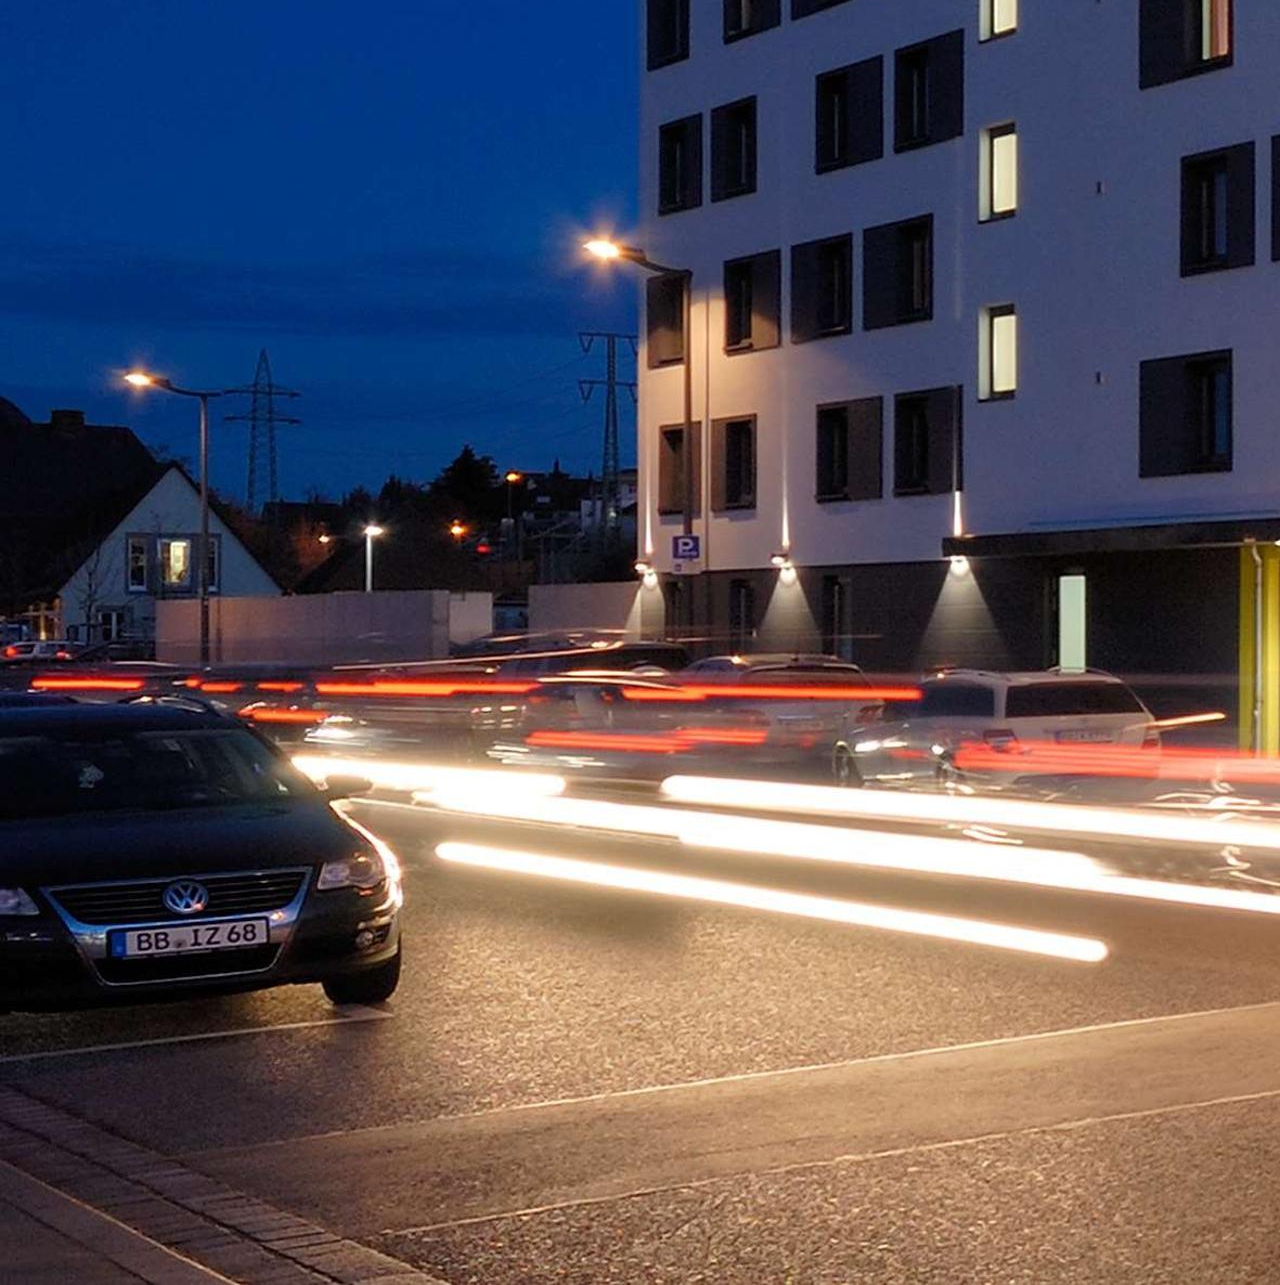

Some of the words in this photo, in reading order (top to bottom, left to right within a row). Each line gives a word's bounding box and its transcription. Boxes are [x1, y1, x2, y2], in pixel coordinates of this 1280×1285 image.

[678, 538, 694, 556] P
[136, 931, 170, 953] BB
[190, 926, 221, 948] IZ
[226, 923, 258, 944] 68
